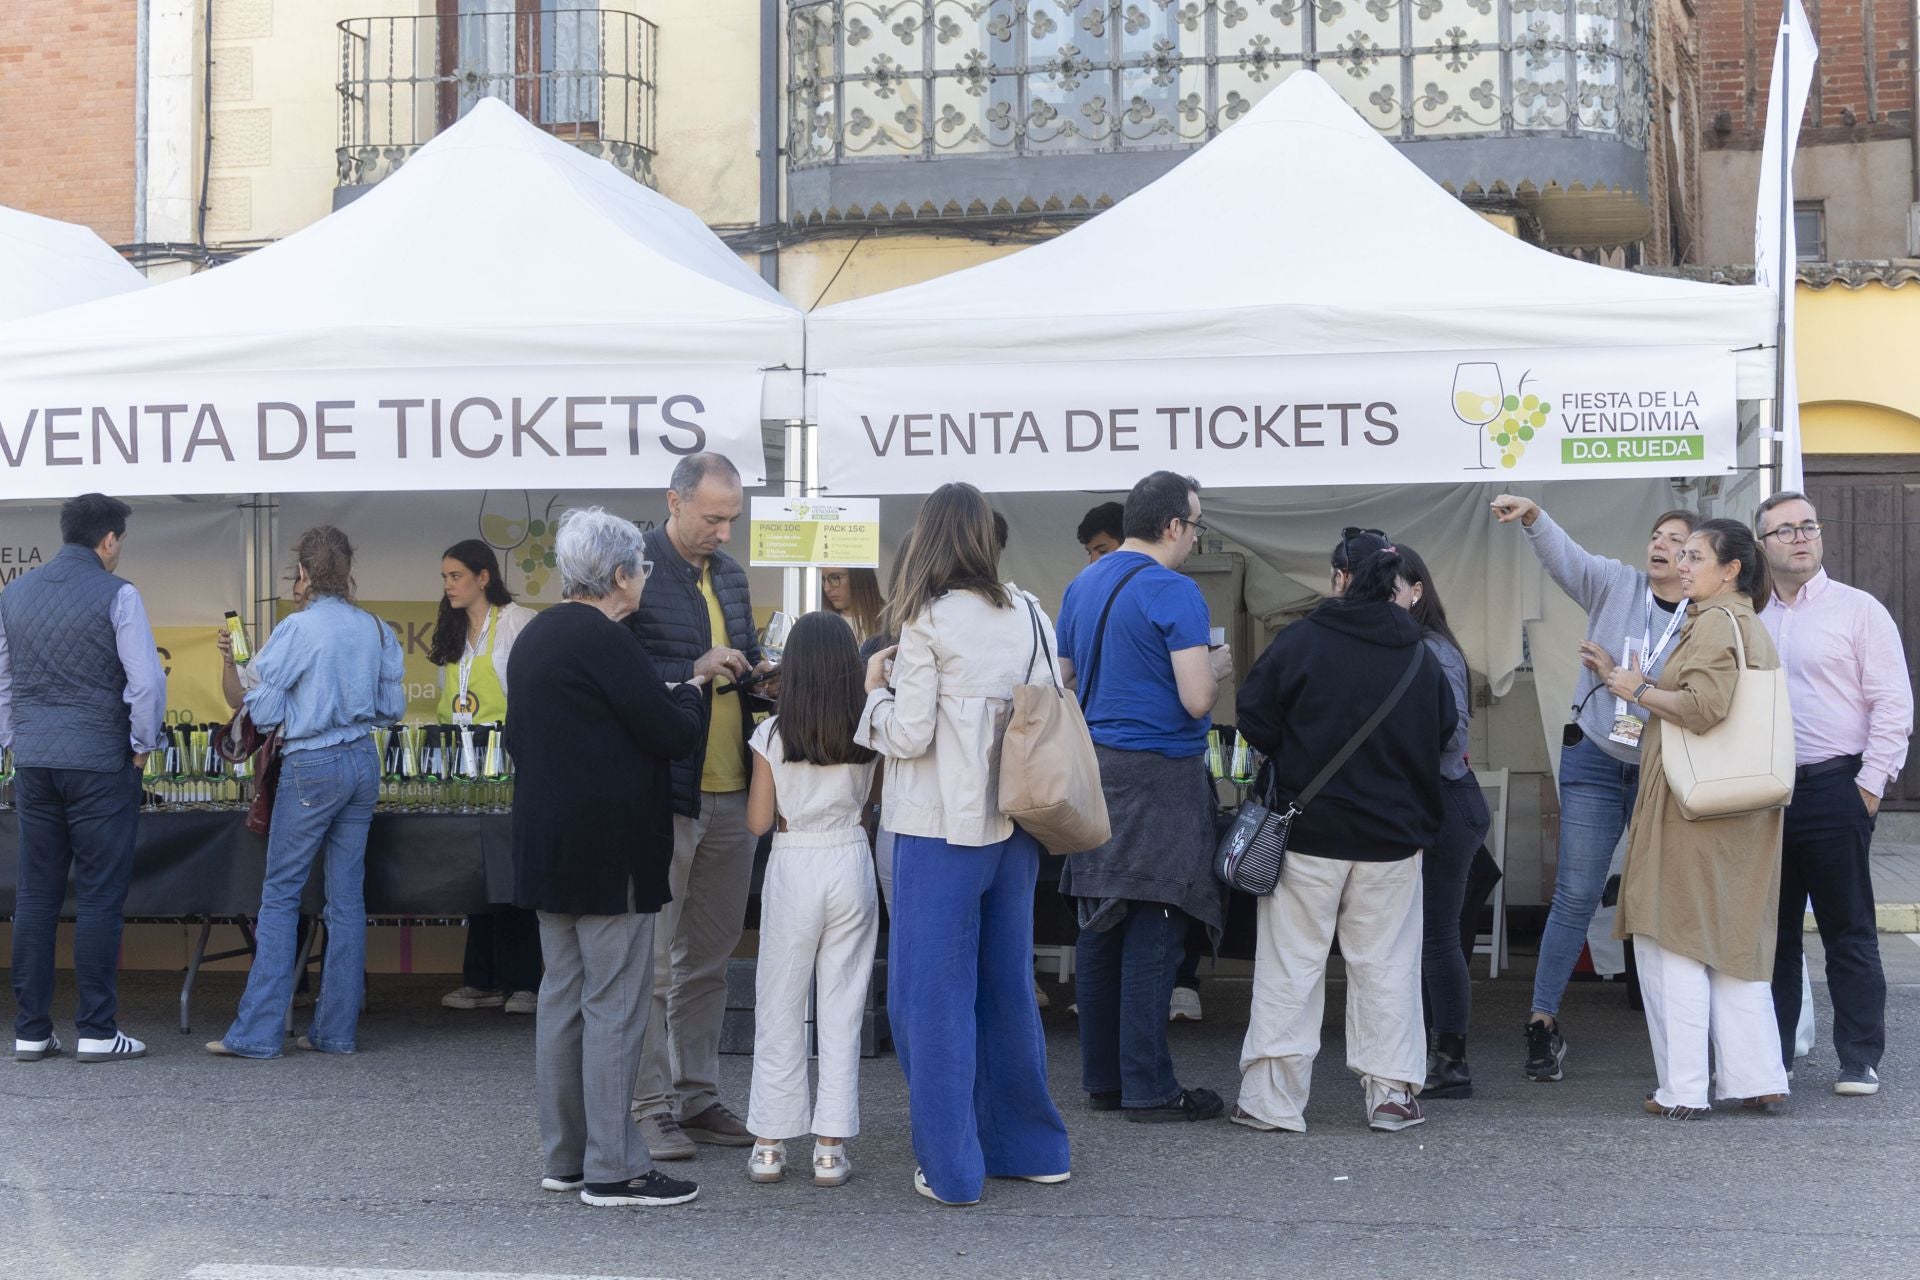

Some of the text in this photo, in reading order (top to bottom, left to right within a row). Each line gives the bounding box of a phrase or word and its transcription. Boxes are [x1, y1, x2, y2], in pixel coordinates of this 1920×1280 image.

[1562, 391, 1700, 409] FIESTA DE LA
[0, 394, 707, 468] VENTA DE TICKETS
[861, 402, 1398, 457] VENTA DE TICKETS
[1561, 411, 1699, 433] VENDIMIA
[1573, 439, 1692, 459] D.O. RUEDA
[760, 524, 782, 532] PACK
[824, 525, 846, 533] PACK
[18, 546, 42, 563] LA
